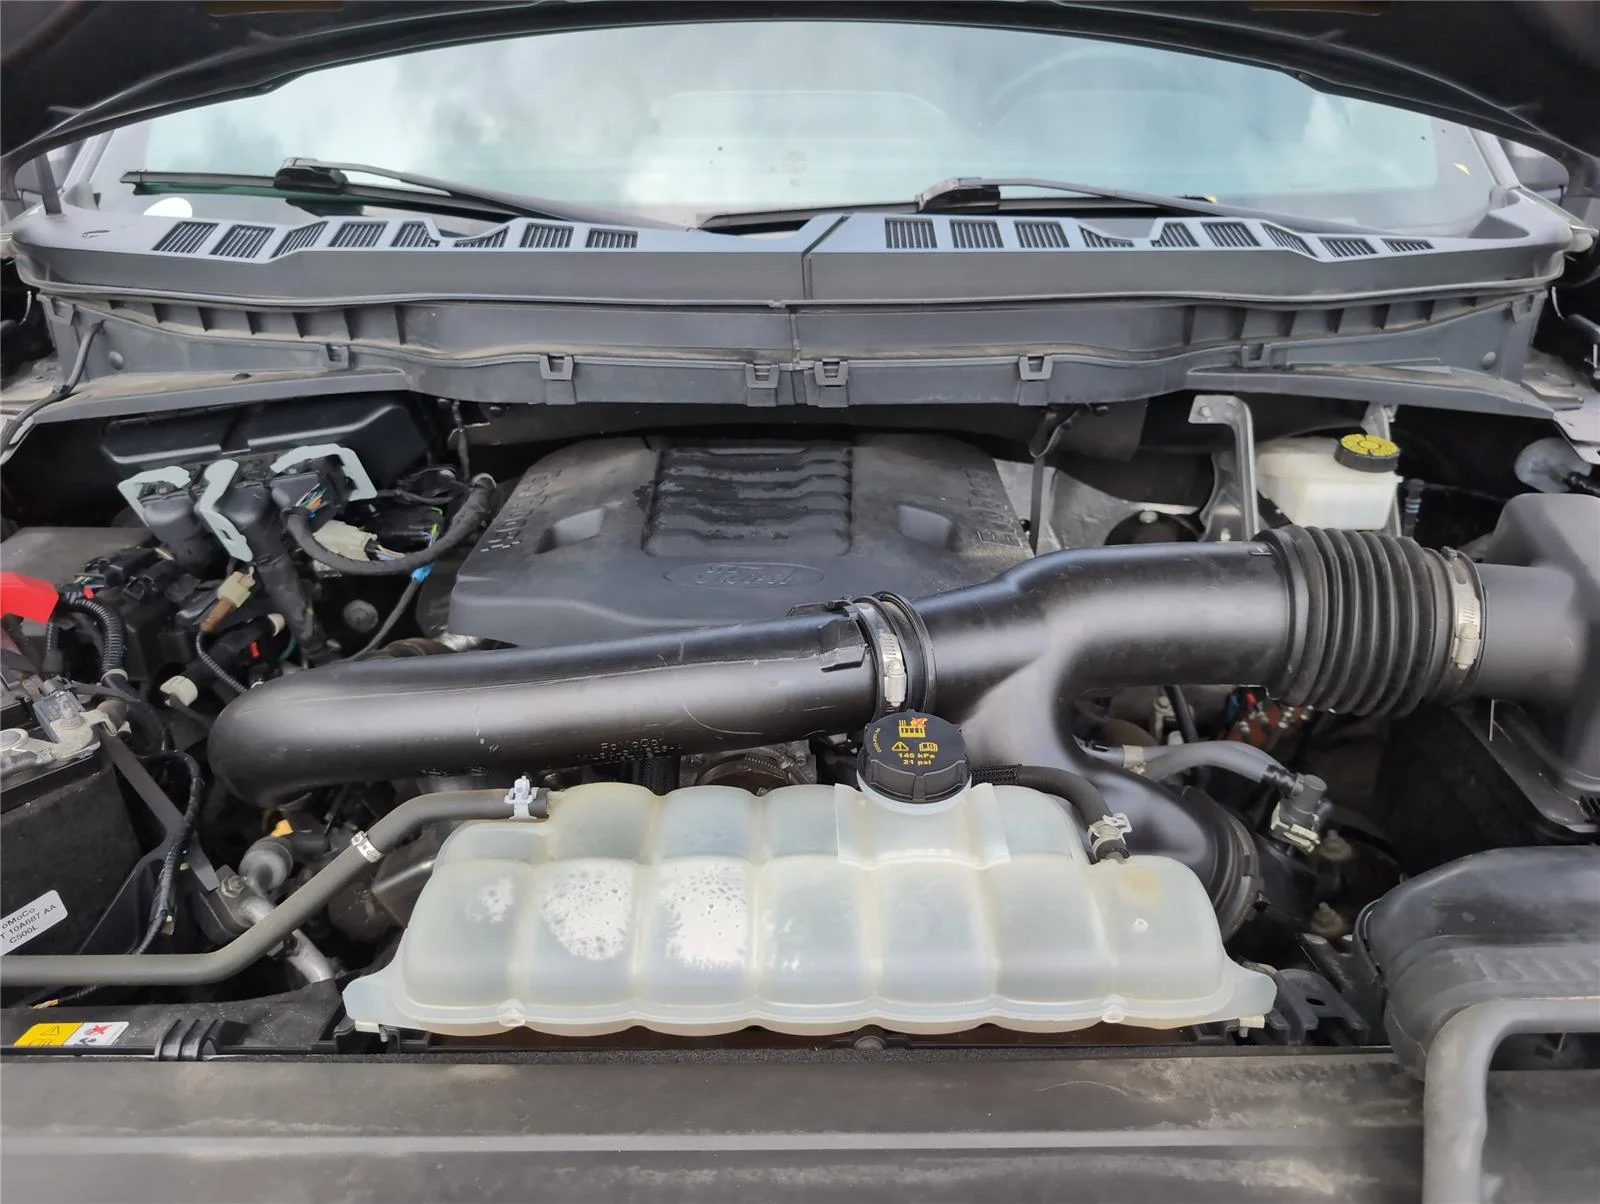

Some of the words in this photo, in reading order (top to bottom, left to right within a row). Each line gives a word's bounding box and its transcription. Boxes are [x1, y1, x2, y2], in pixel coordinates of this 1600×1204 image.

[695, 563, 800, 587] Ford
[1, 908, 36, 929] oMoCo
[43, 904, 57, 915] AA
